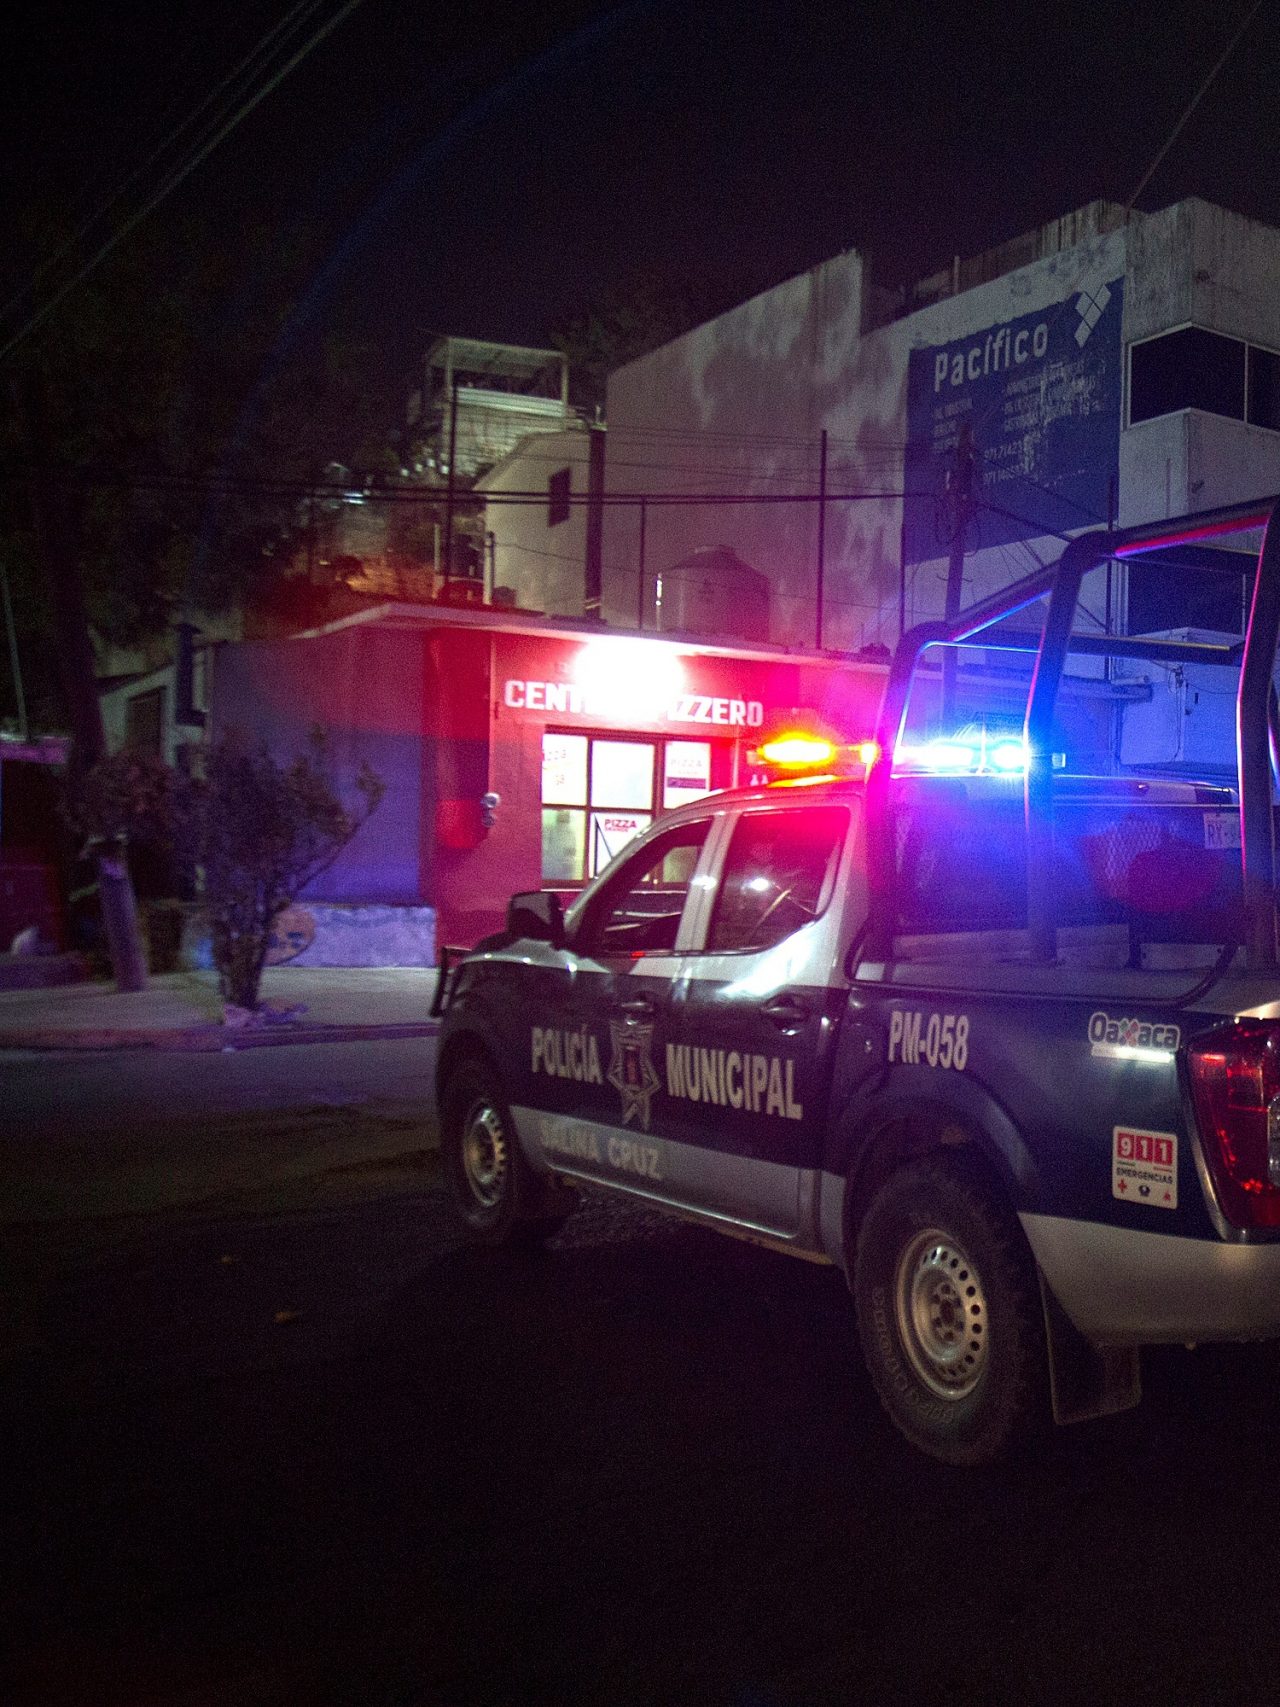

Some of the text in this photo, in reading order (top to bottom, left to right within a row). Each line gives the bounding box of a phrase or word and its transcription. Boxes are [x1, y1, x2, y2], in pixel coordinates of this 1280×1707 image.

[604, 818, 637, 828] PIZZA
[888, 1011, 969, 1071] PM-058
[1090, 1013, 1179, 1049] Oaxaca
[531, 1024, 804, 1120] POLICÍA MUNICIPAL
[607, 1136, 664, 1181] CRUZ
[1119, 1135, 1169, 1163] 911
[1116, 1167, 1174, 1185] EMERGENCIAS
